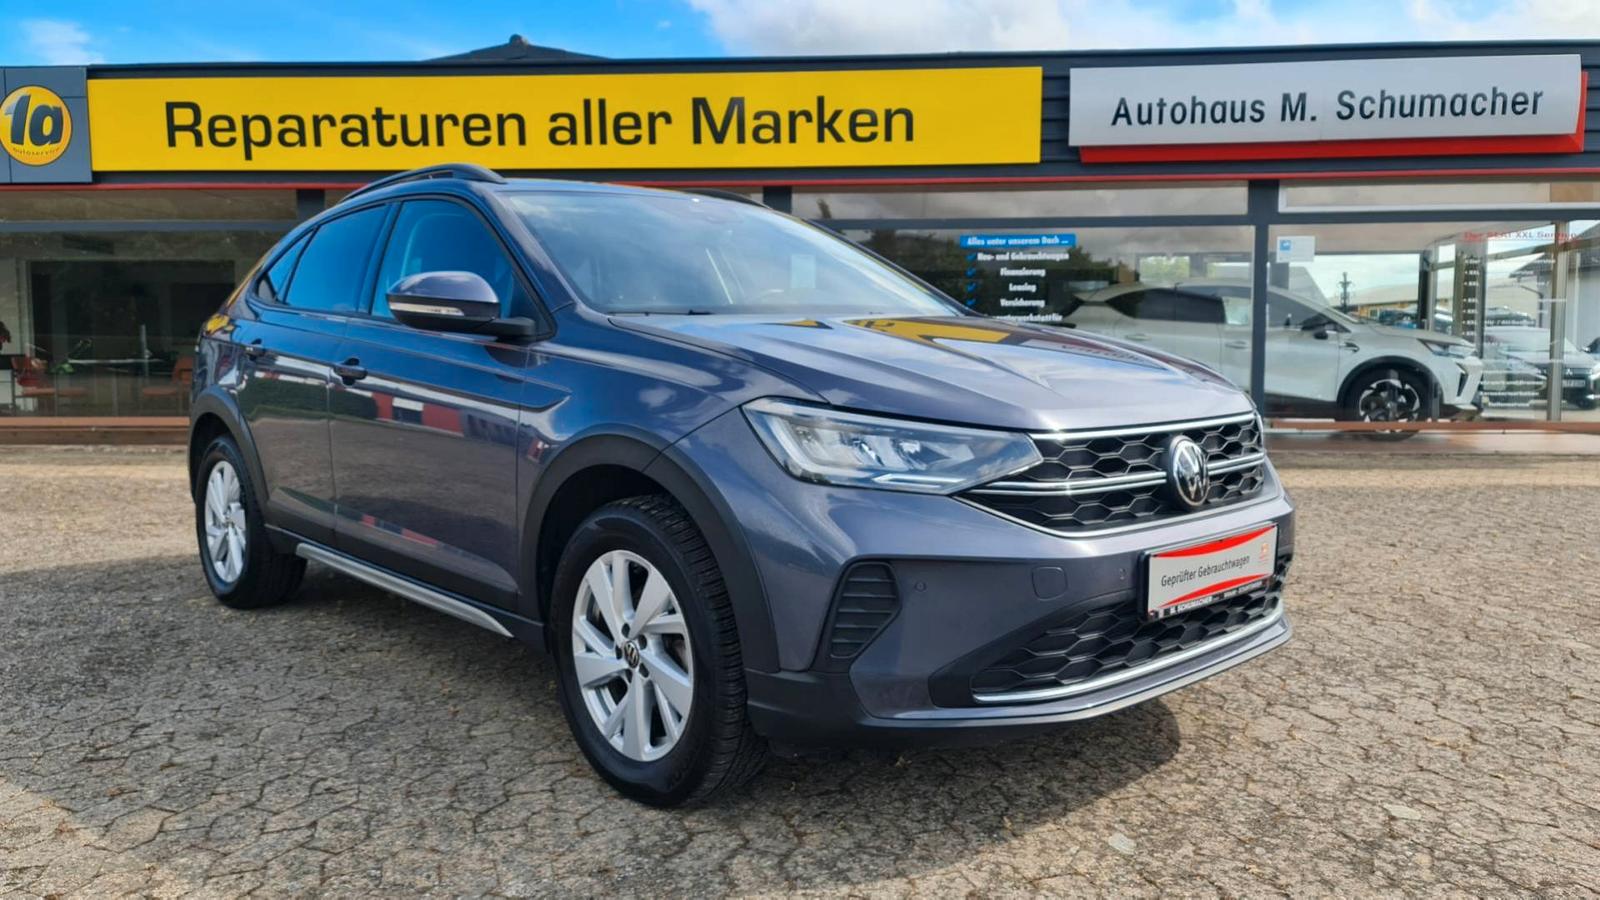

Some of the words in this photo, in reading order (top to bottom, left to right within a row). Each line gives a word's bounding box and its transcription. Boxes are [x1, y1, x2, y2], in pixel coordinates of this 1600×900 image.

[1110, 95, 1265, 127] Autohaus
[1280, 92, 1317, 123] M.
[1335, 86, 1544, 121] Schumacher
[4, 93, 64, 147] 1a
[164, 101, 526, 161] Reparaturen
[548, 98, 672, 146] aller
[692, 95, 914, 145] Marken
[967, 237, 985, 246] Alles
[986, 237, 1006, 246] unter
[1008, 237, 1040, 245] unserem
[1041, 236, 1060, 245] Dach
[996, 251, 1010, 261] und
[1000, 267, 1046, 277] Finanzierung
[1008, 283, 1037, 292] Leasing
[1000, 298, 1046, 308] Versicherung
[1160, 569, 1197, 588] Geprüfter
[1197, 555, 1251, 578] Gebrauchtwagen
